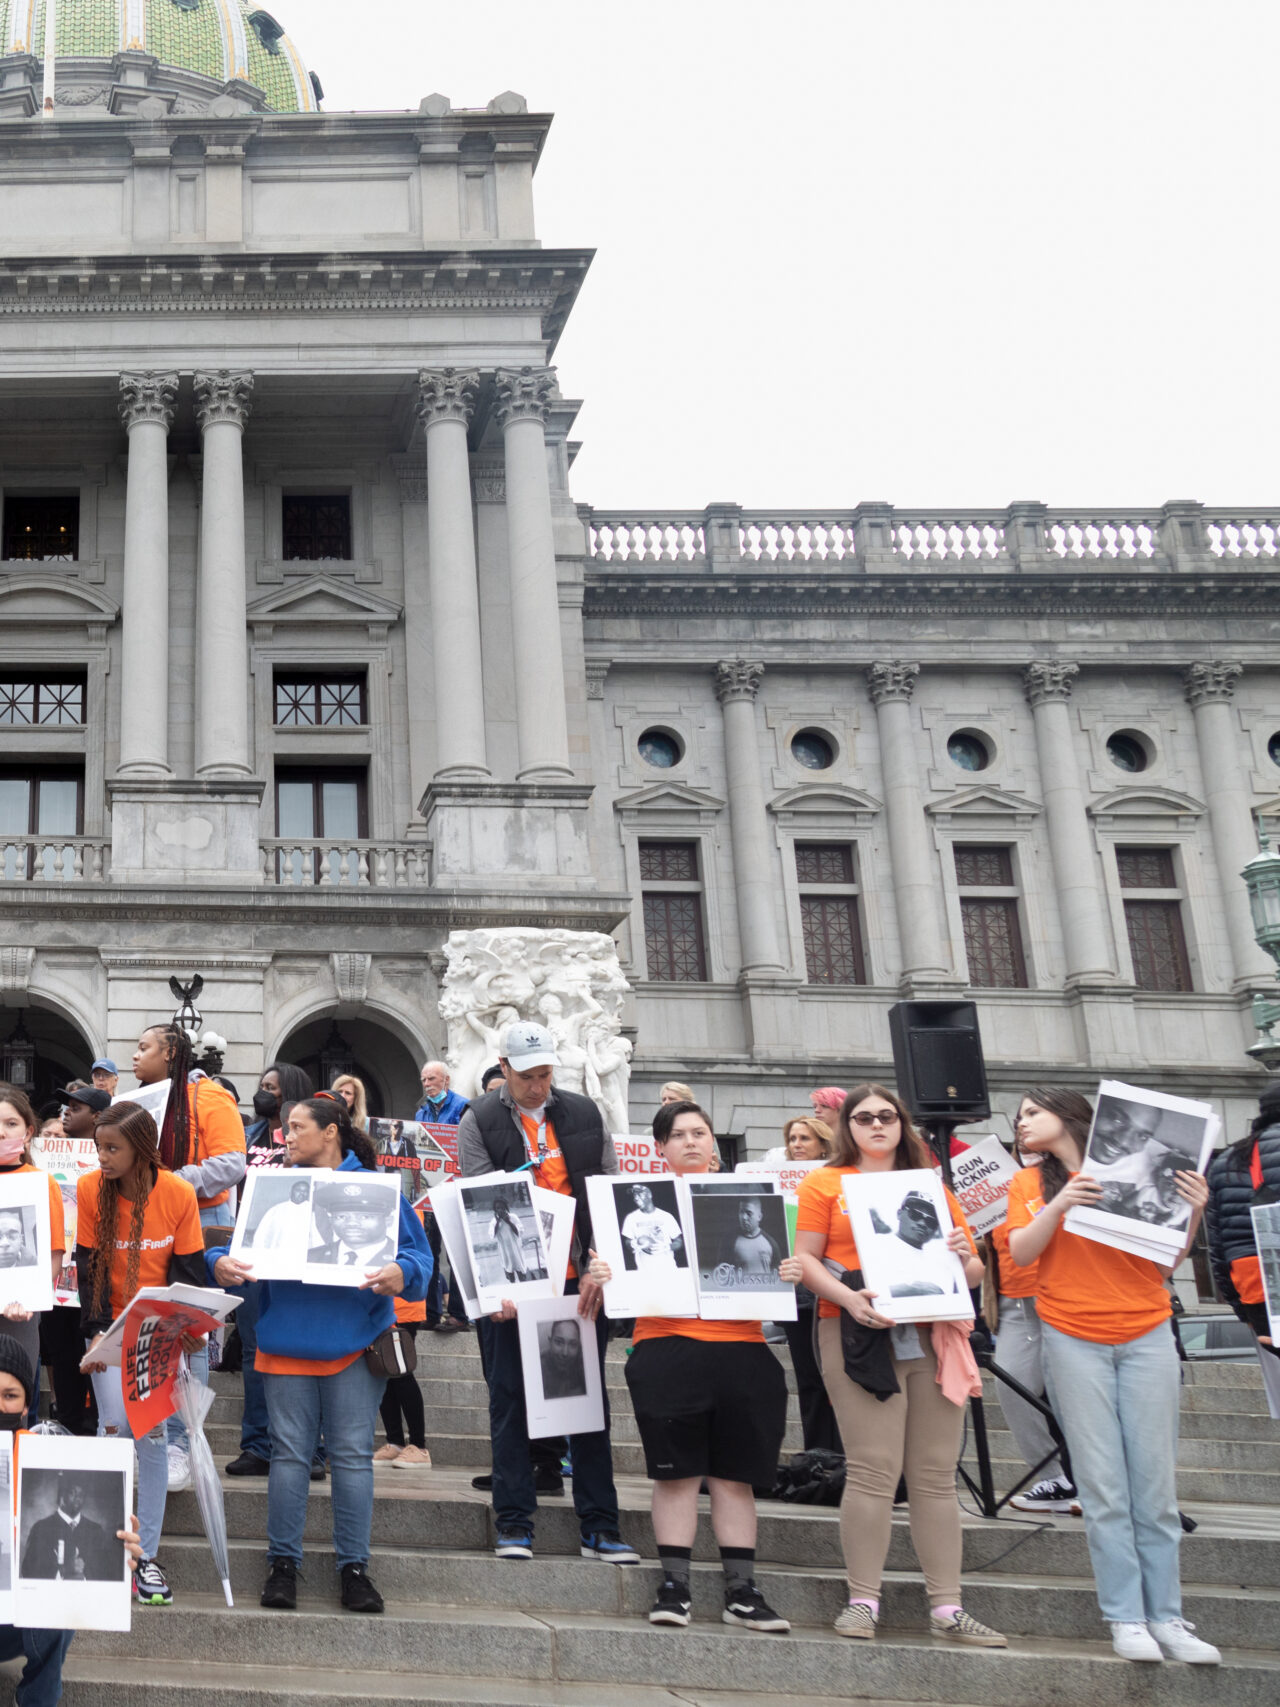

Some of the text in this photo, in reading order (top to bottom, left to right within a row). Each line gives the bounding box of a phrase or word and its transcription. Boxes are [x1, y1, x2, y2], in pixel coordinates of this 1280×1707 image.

[40, 1139, 75, 1154] JOHN
[614, 1142, 650, 1157] END
[376, 1154, 462, 1175] VOICES OF BL
[619, 1158, 671, 1174] IOLEN
[957, 1156, 984, 1177] GUN
[951, 1161, 1001, 1193] FICKING
[959, 1179, 992, 1205] PORT
[136, 1320, 160, 1398] FREE
[150, 1337, 164, 1390] FROM
[126, 1344, 138, 1402] A LIFE
